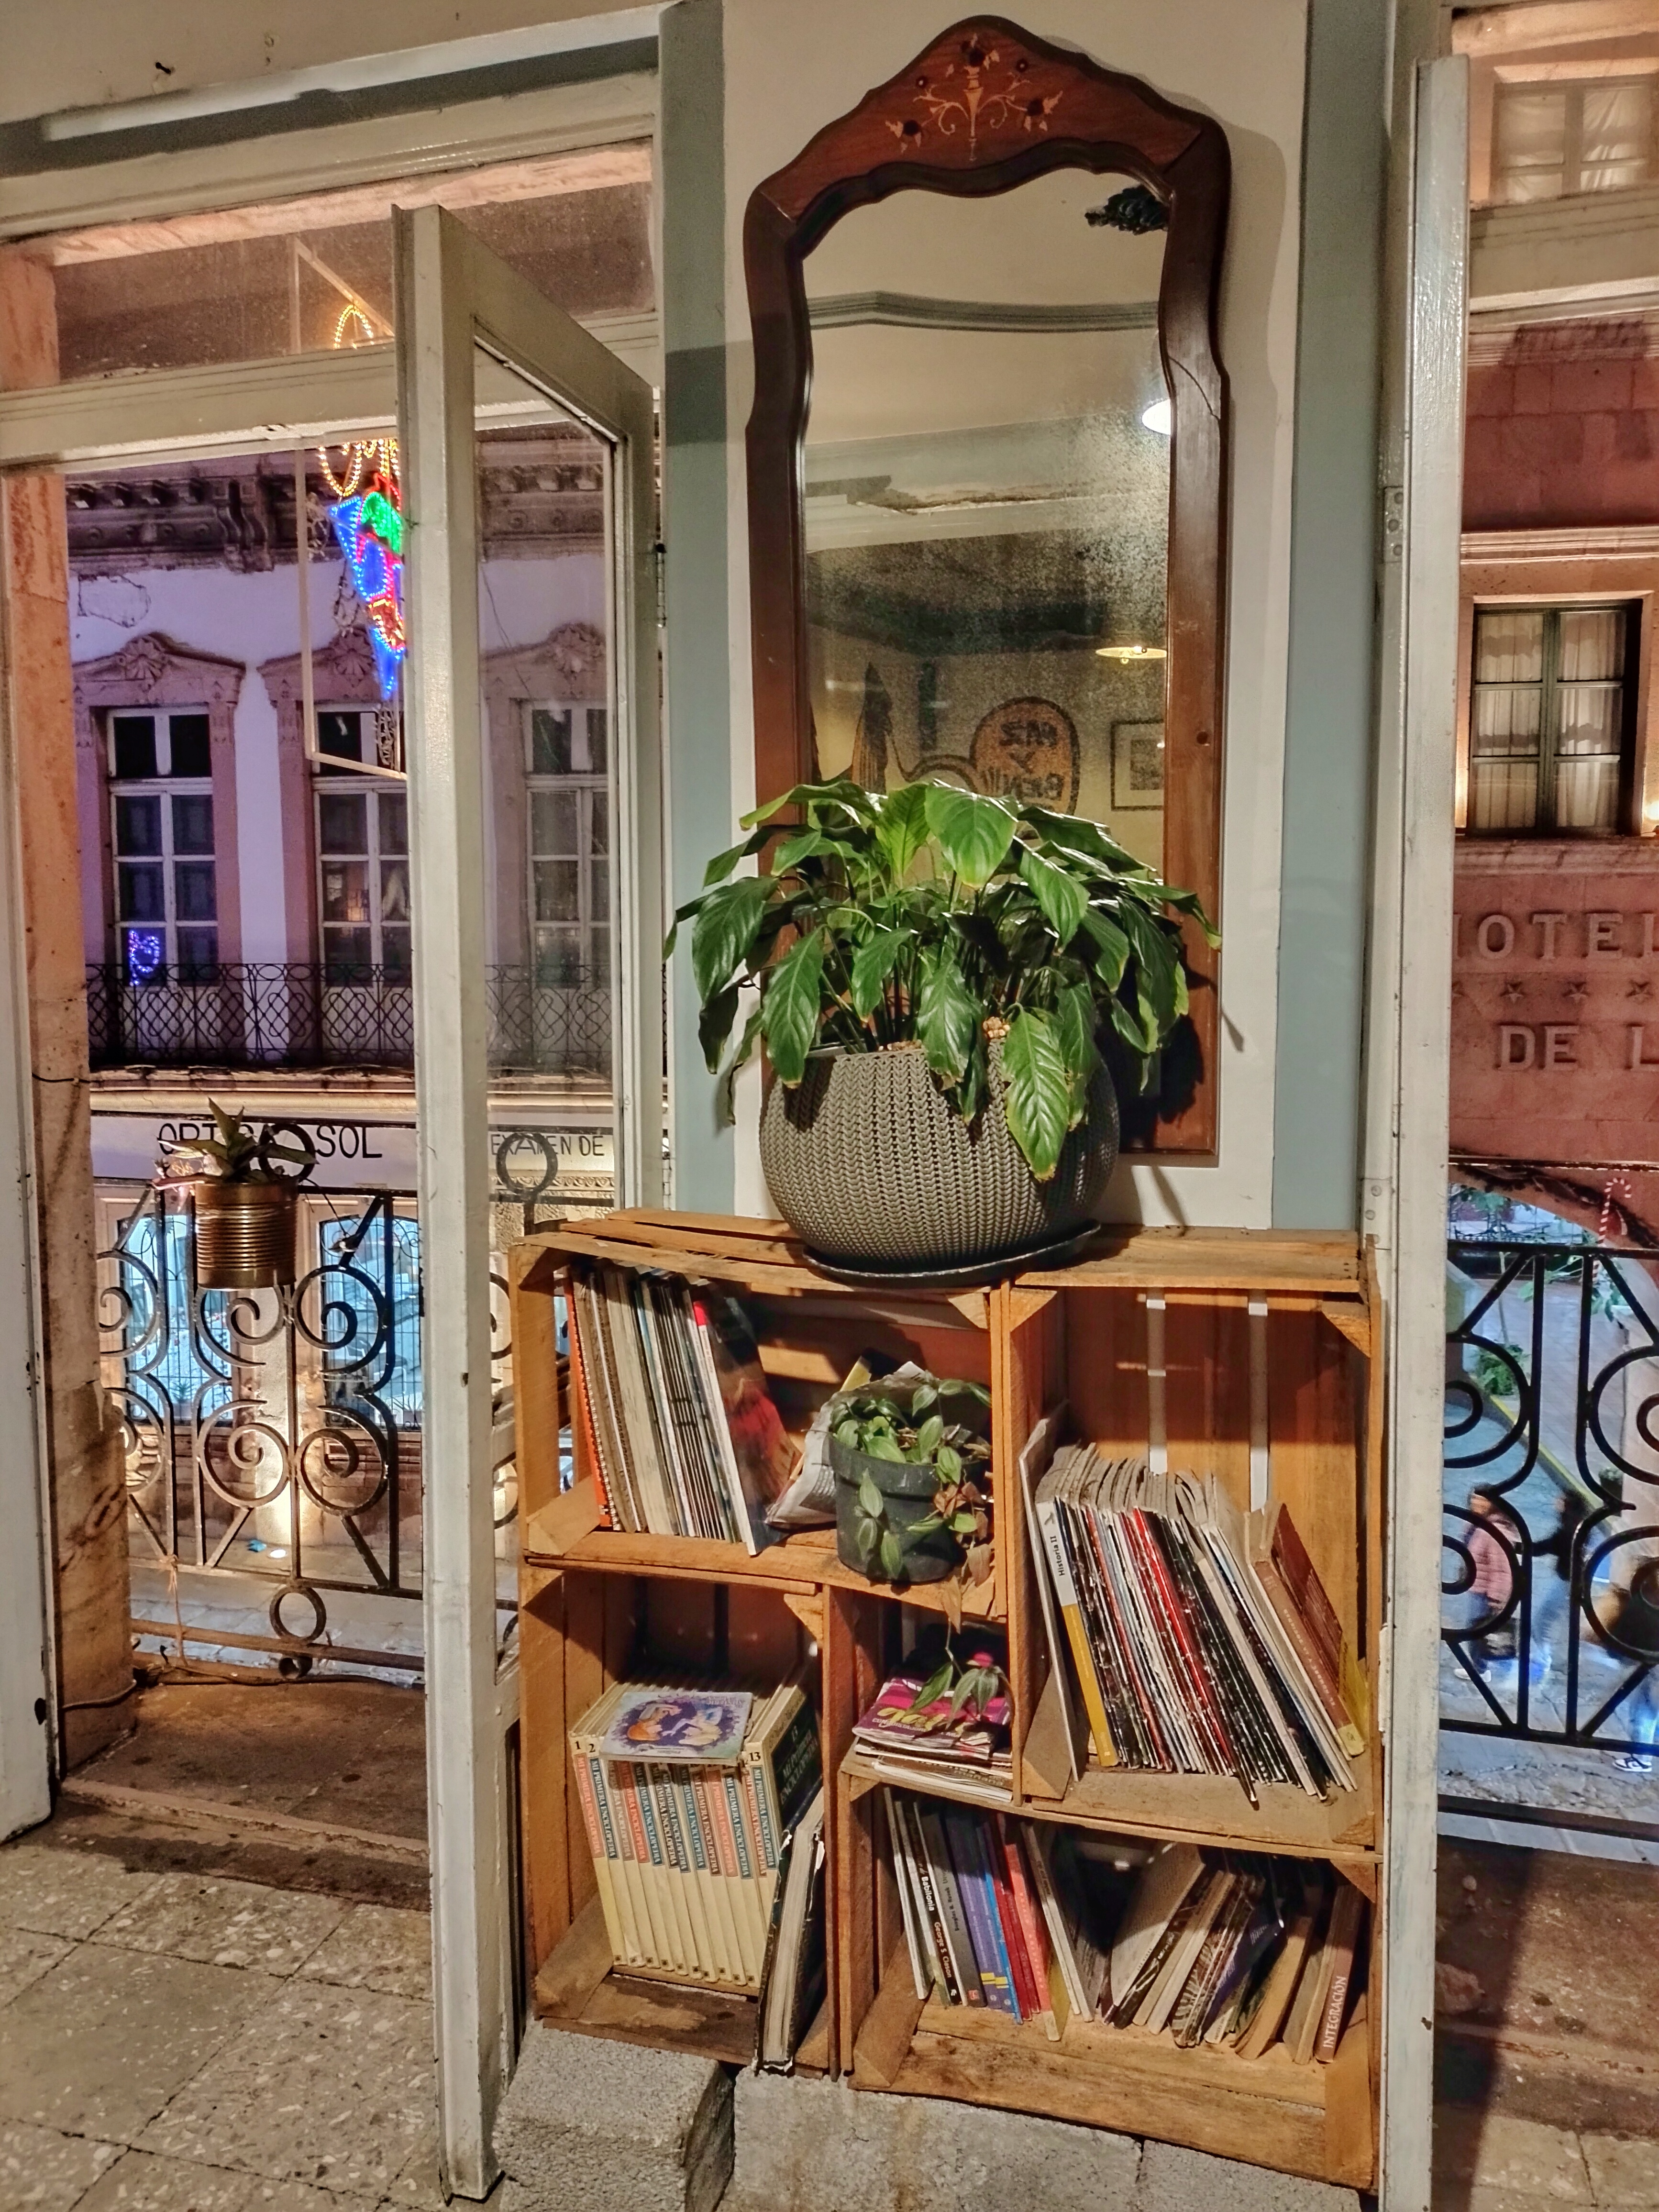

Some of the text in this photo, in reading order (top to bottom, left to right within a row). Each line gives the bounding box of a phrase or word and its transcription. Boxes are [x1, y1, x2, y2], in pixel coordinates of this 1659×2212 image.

[1453, 910, 1659, 959] OTEL
[1497, 1024, 1579, 1072] DE
[316, 1126, 382, 1158] SOL
[579, 1136, 605, 1156] DE
[1053, 1544, 1065, 1576] Historia
[575, 1741, 581, 1750] 1
[588, 1744, 596, 1753] 2
[750, 1752, 761, 1761] 13
[591, 1760, 615, 1856] MI PRIMERA ENCICLOPEDIA
[664, 1784, 676, 1817] PRIMERA
[671, 1818, 686, 1869] ENCICLOPEDIA
[696, 1786, 708, 1820] PRIMERA
[702, 1821, 718, 1872] ENCICLOPEDIA
[725, 1778, 749, 1875] MI PRIMERA ENCICLOPEDIA
[753, 1769, 775, 1866] MI PRIMERA ENCICLOPEDIA
[644, 1811, 660, 1862] ENCICLOPEDIA
[661, 1813, 677, 1864] ENCICLOPEDIA
[689, 1814, 704, 1866] ENCICLOPEDIA
[921, 1876, 935, 1912] Babilonia
[934, 1921, 944, 1947] George
[943, 1956, 952, 1978] Clason
[1323, 1976, 1347, 2048] INTEGRACIÓN
